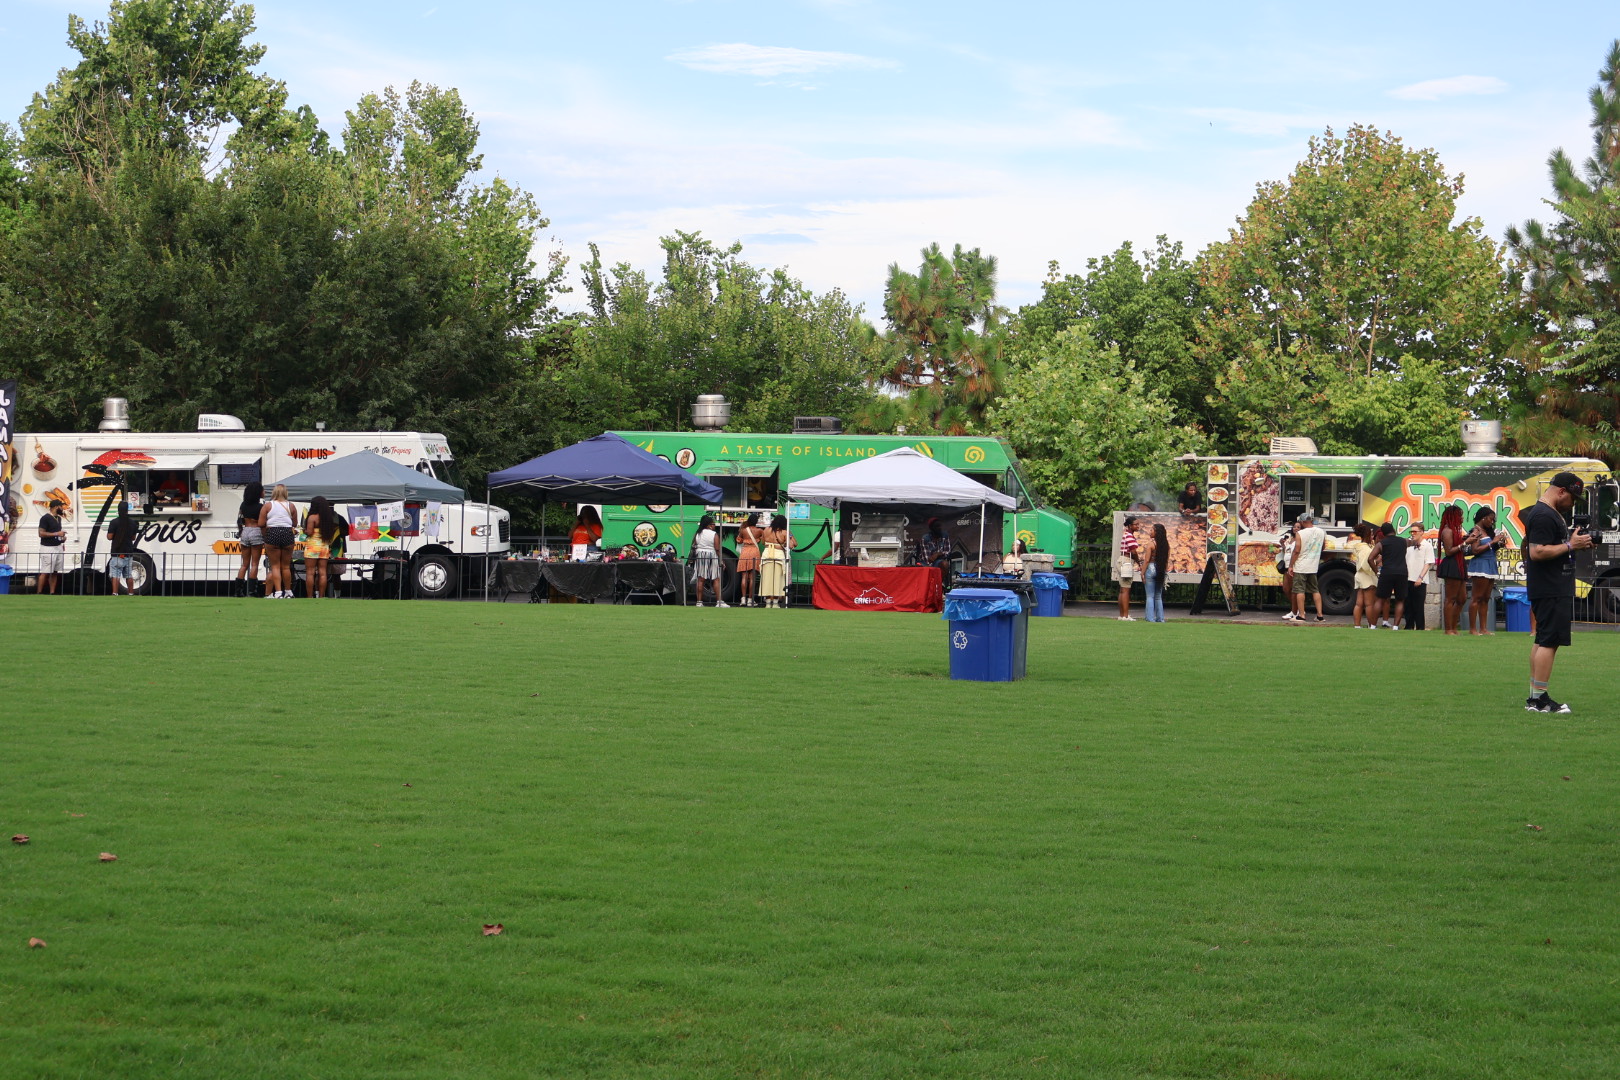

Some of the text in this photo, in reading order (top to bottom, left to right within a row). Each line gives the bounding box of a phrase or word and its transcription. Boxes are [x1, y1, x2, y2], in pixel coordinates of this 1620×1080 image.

[292, 448, 328, 460] VISIT US
[720, 445, 877, 457] A TASTE OF ISLAND
